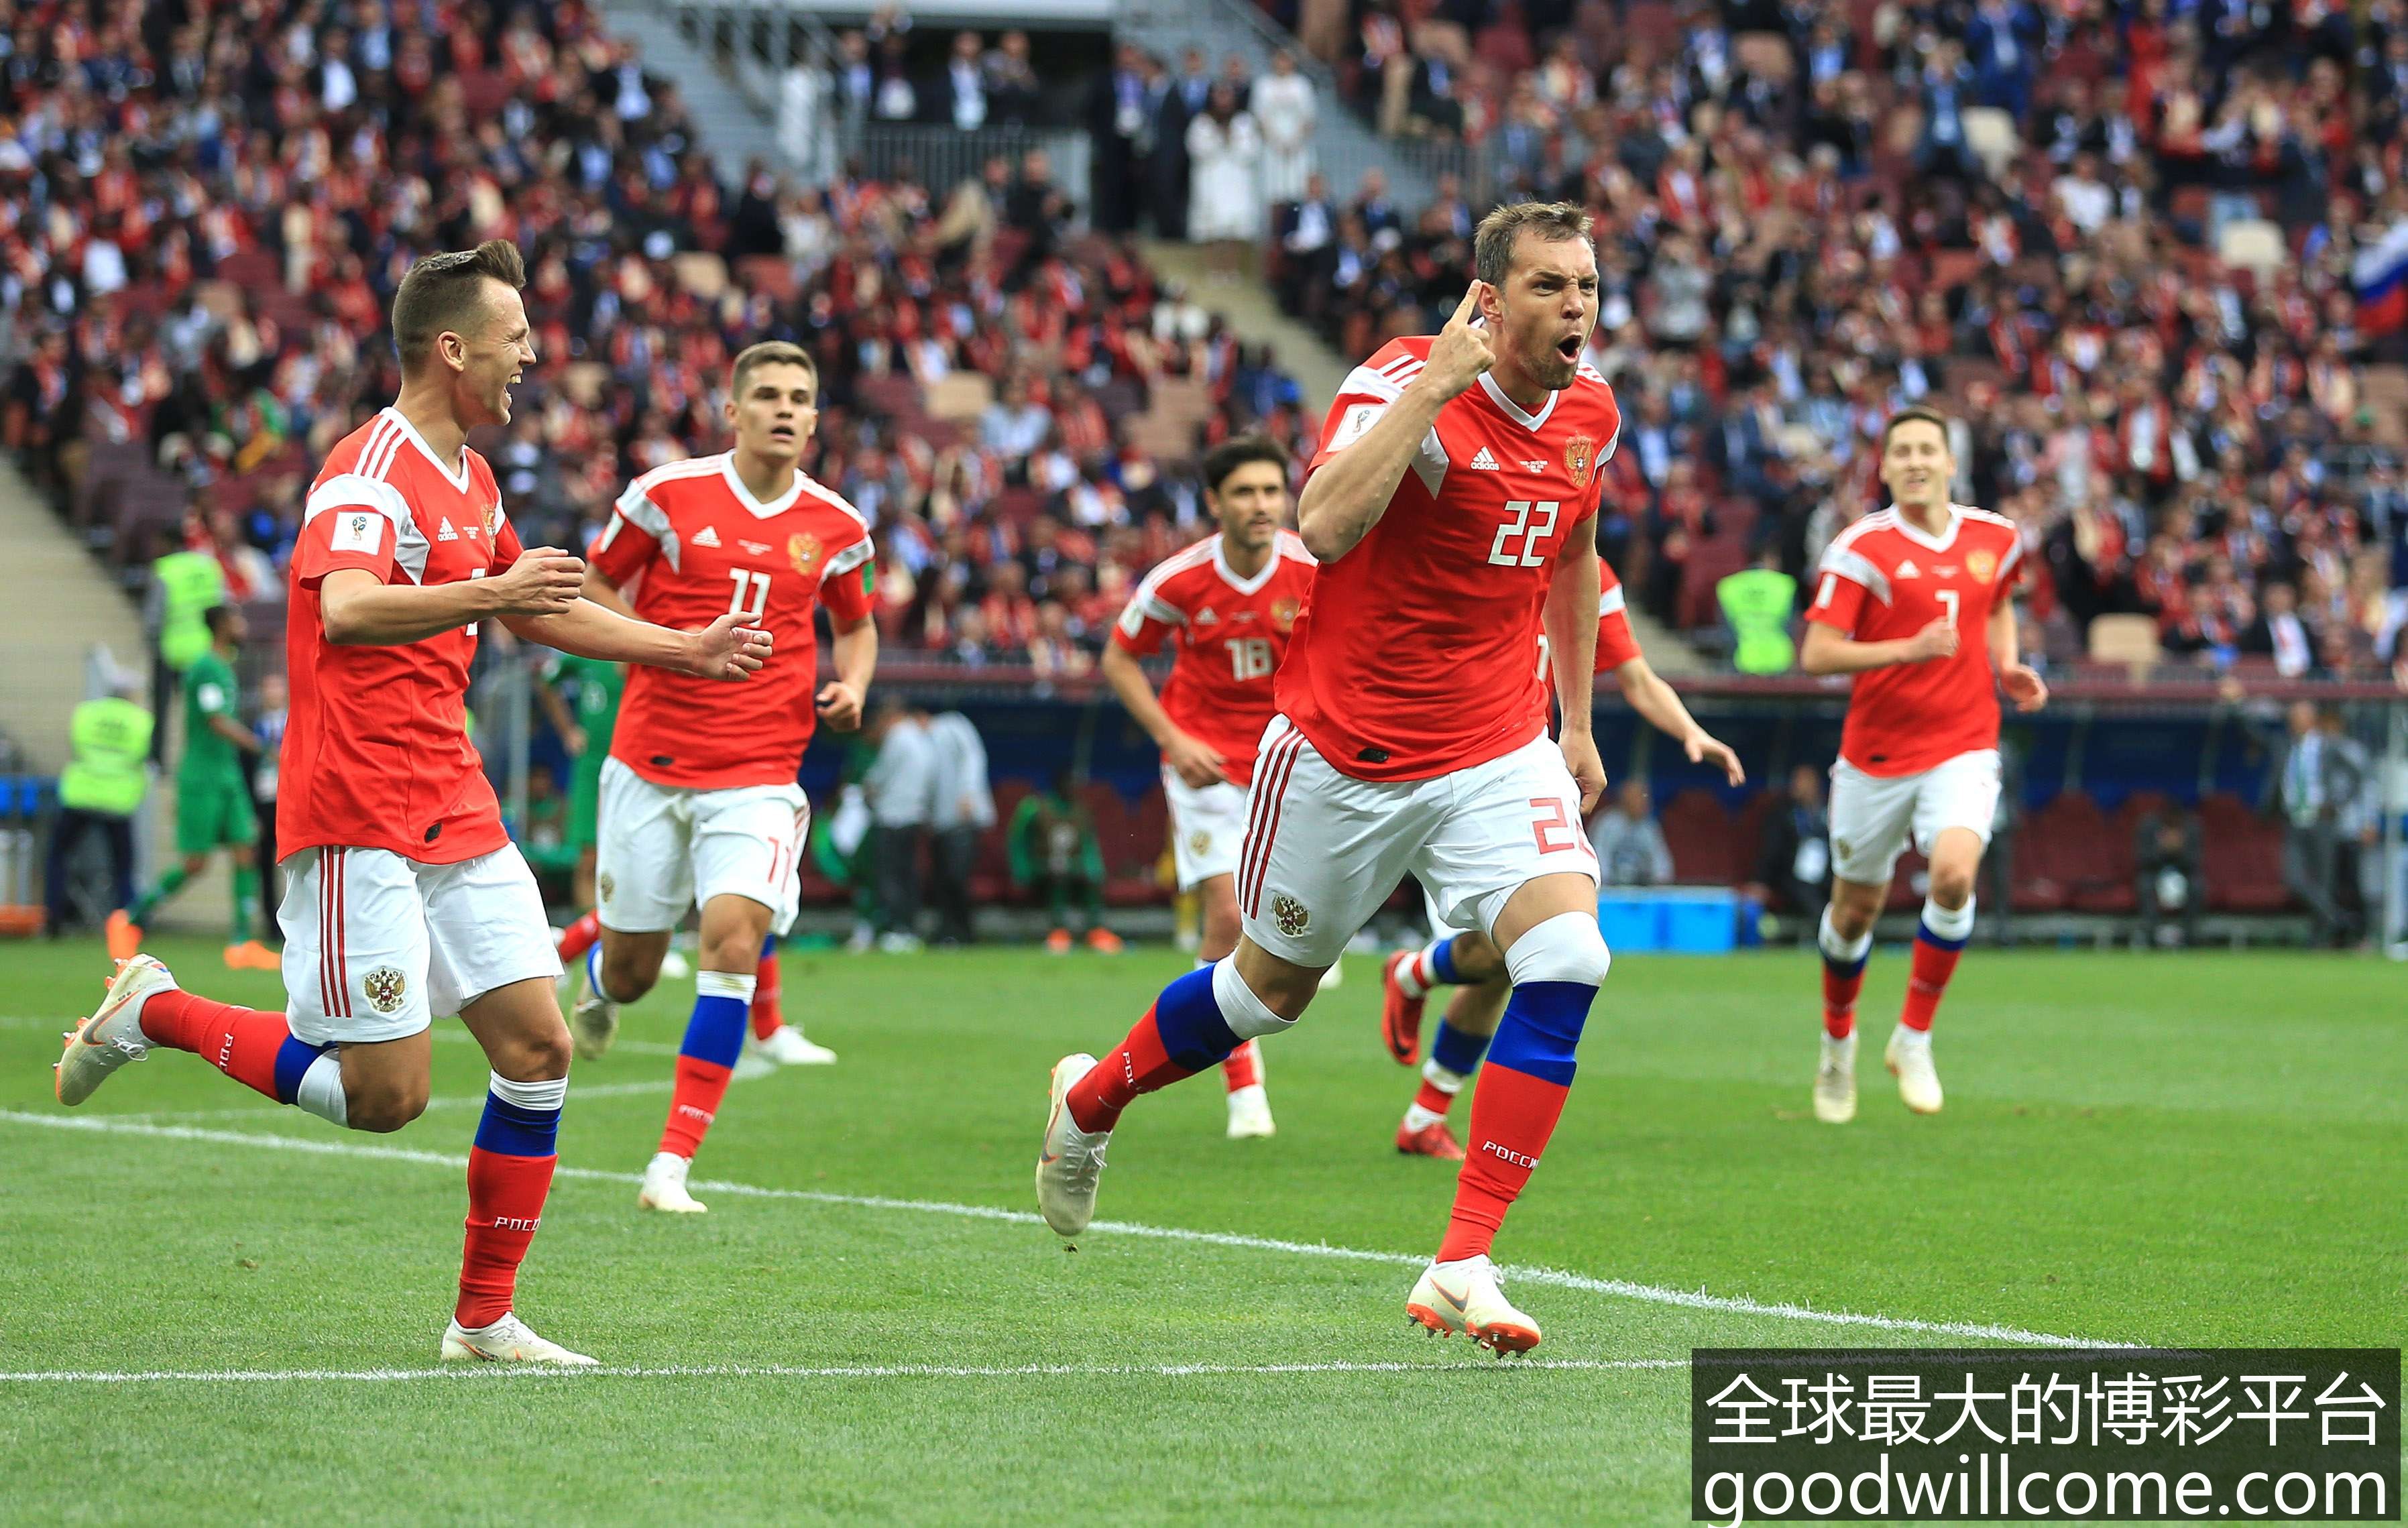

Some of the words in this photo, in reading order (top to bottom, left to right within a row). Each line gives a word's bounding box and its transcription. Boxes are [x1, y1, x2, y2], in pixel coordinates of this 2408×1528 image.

[1471, 461, 1500, 471] adidas
[1487, 501, 1560, 567] 22
[729, 567, 772, 628] 11
[1224, 638, 1273, 682] 18
